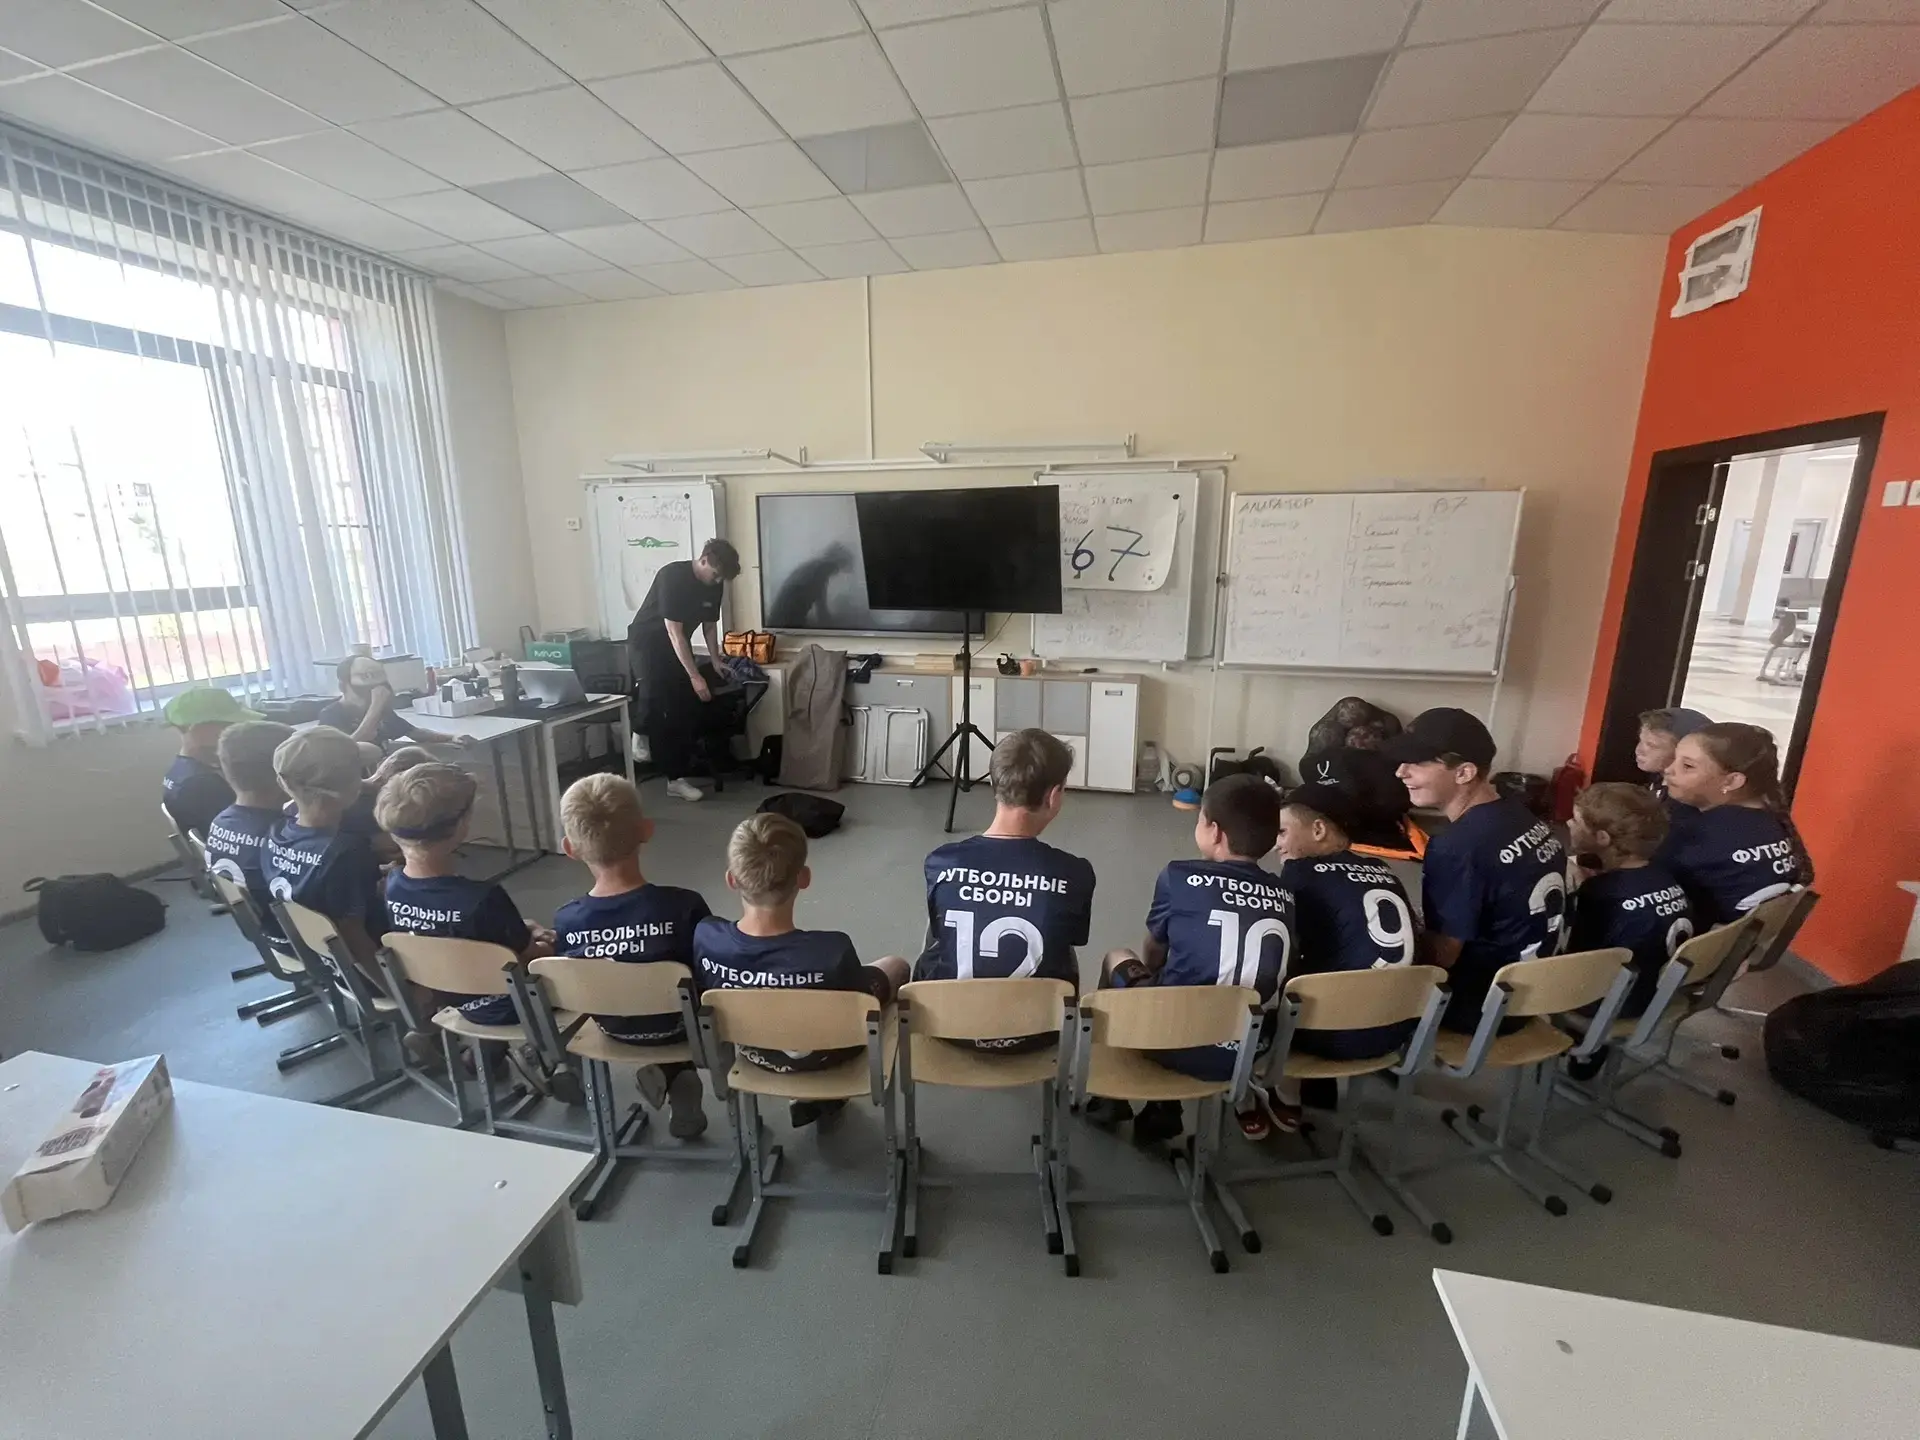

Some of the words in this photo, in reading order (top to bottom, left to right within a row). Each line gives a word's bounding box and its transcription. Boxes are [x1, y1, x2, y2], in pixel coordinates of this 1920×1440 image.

[1069, 526, 1151, 582] 67
[207, 835, 240, 856] СБОРЫ
[959, 885, 1033, 908] СБОРЫ
[1186, 874, 1295, 906] ФУТБОЛЬНЫ
[1222, 891, 1285, 914] СБОРЫ
[565, 921, 674, 946] ФУТБОЛЬНЫЕ
[1362, 888, 1415, 969] 9
[584, 939, 645, 959] СБОРЫ
[944, 909, 1044, 980] 12
[701, 957, 825, 986] ФУТБОЛЬНЫЕ
[1206, 909, 1290, 1013] 10
